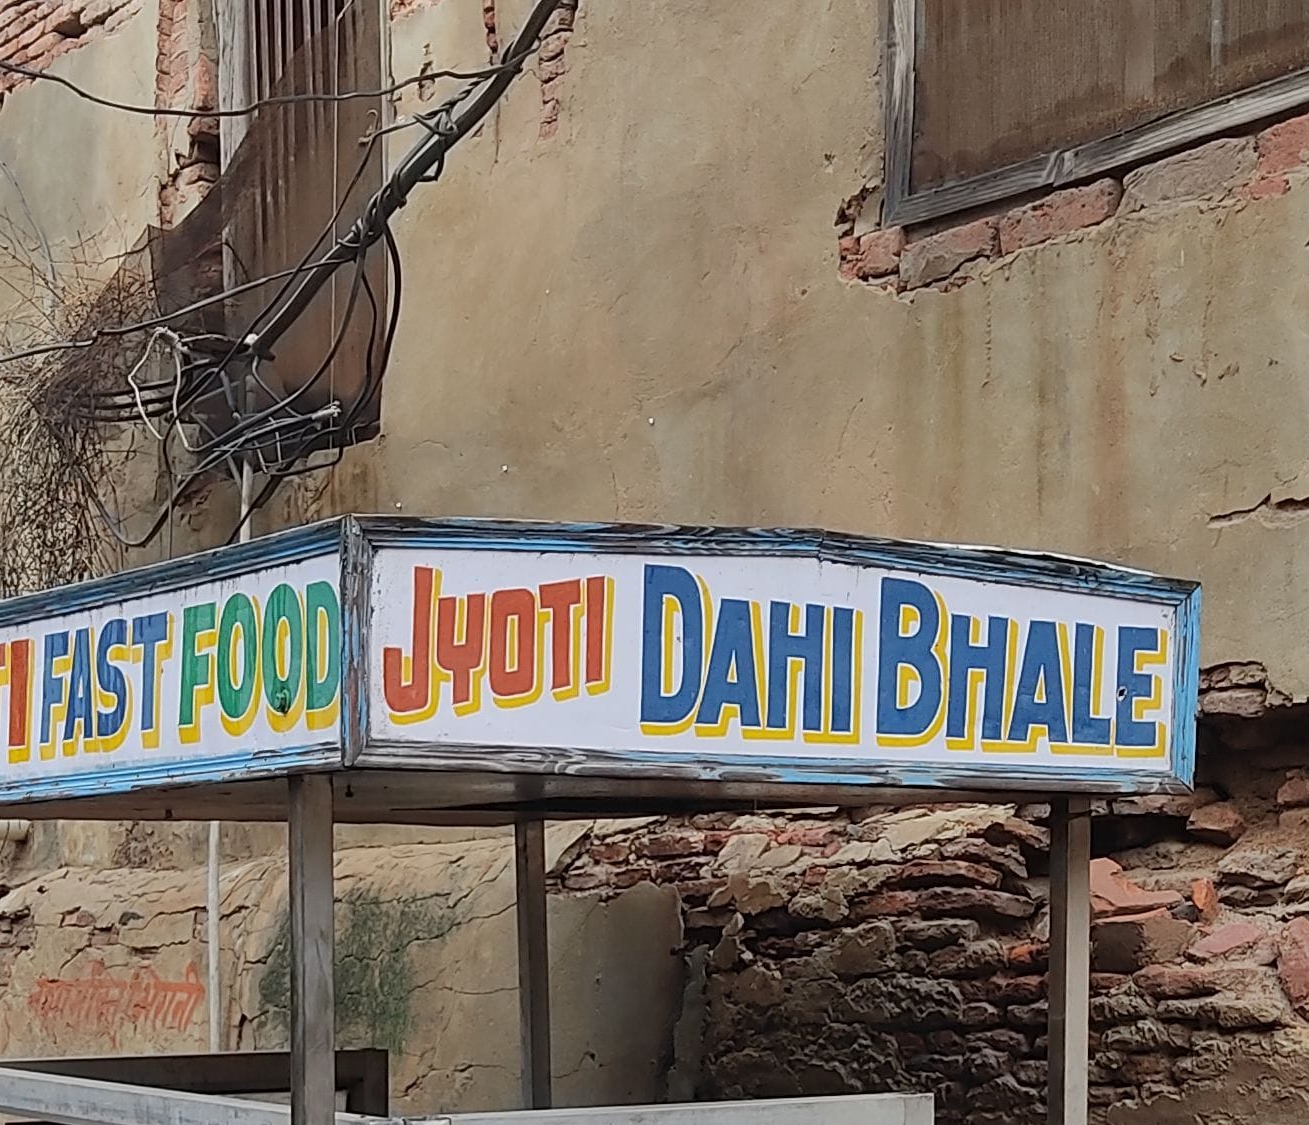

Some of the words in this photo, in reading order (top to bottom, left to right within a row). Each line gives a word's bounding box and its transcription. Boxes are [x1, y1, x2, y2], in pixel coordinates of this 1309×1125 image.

[39, 611, 173, 762] FAST
[178, 580, 341, 744] FOOD
[383, 566, 613, 724] JYOTI
[639, 563, 862, 744] DAHI
[876, 577, 1168, 757] BHALE
